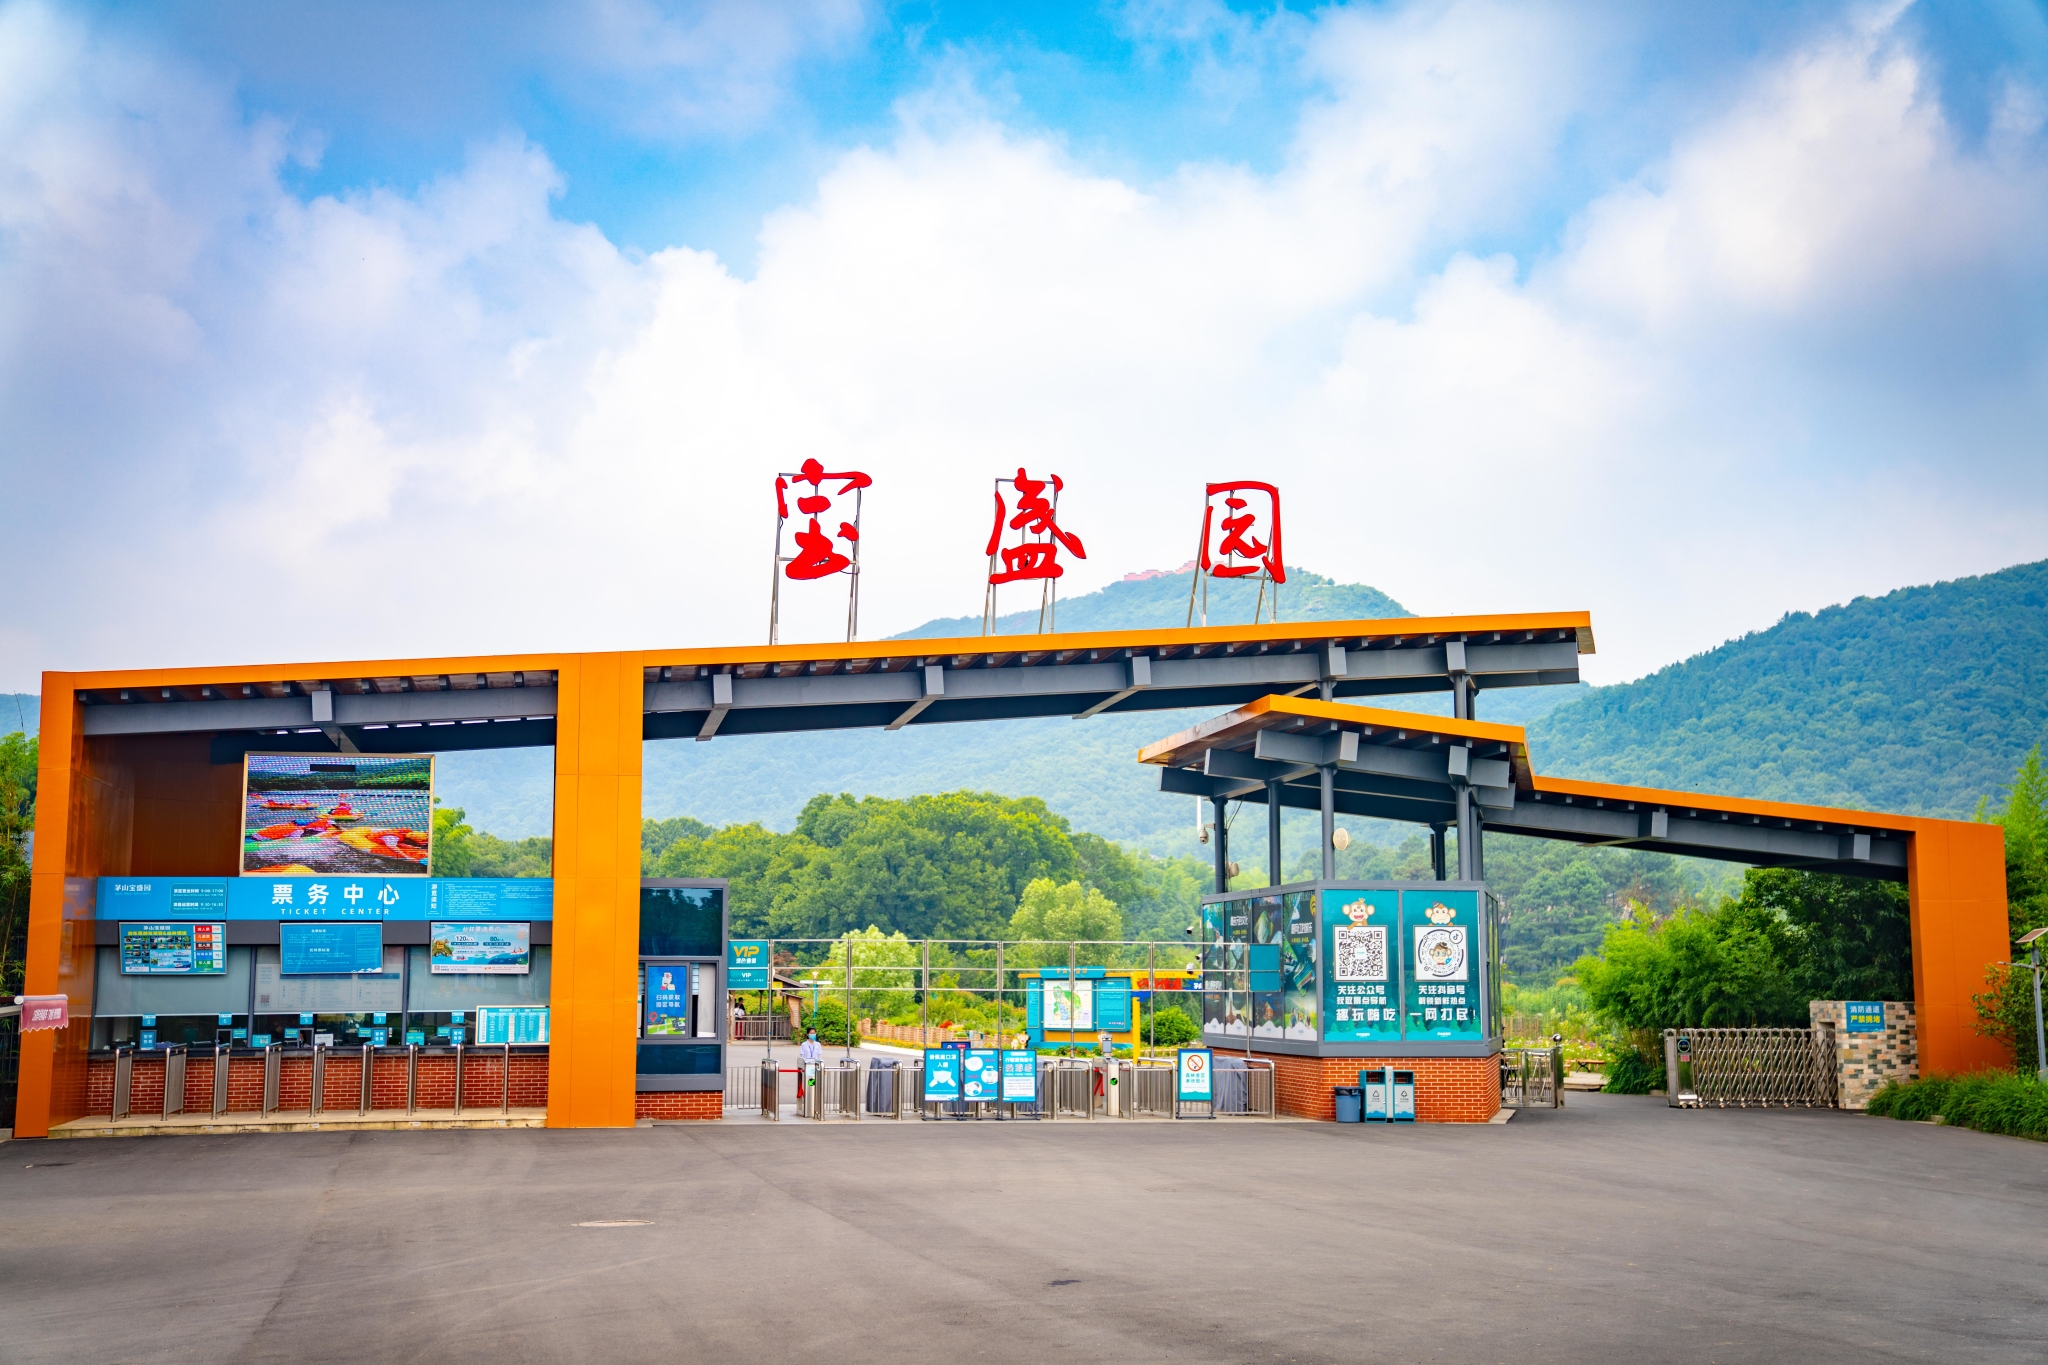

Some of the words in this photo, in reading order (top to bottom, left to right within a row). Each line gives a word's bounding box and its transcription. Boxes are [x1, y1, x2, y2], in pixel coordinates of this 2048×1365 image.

[775, 458, 1287, 585] 宝盛园
[271, 883, 400, 906] 票务中心
[733, 945, 760, 957] VIP
[1337, 985, 1385, 995] 关注公众号
[1418, 985, 1466, 995] 关注抖音号
[1336, 996, 1387, 1005] 获取景点导航
[1336, 1008, 1396, 1021] 趣玩嗨吃
[1850, 1005, 1880, 1013] 消防通道
